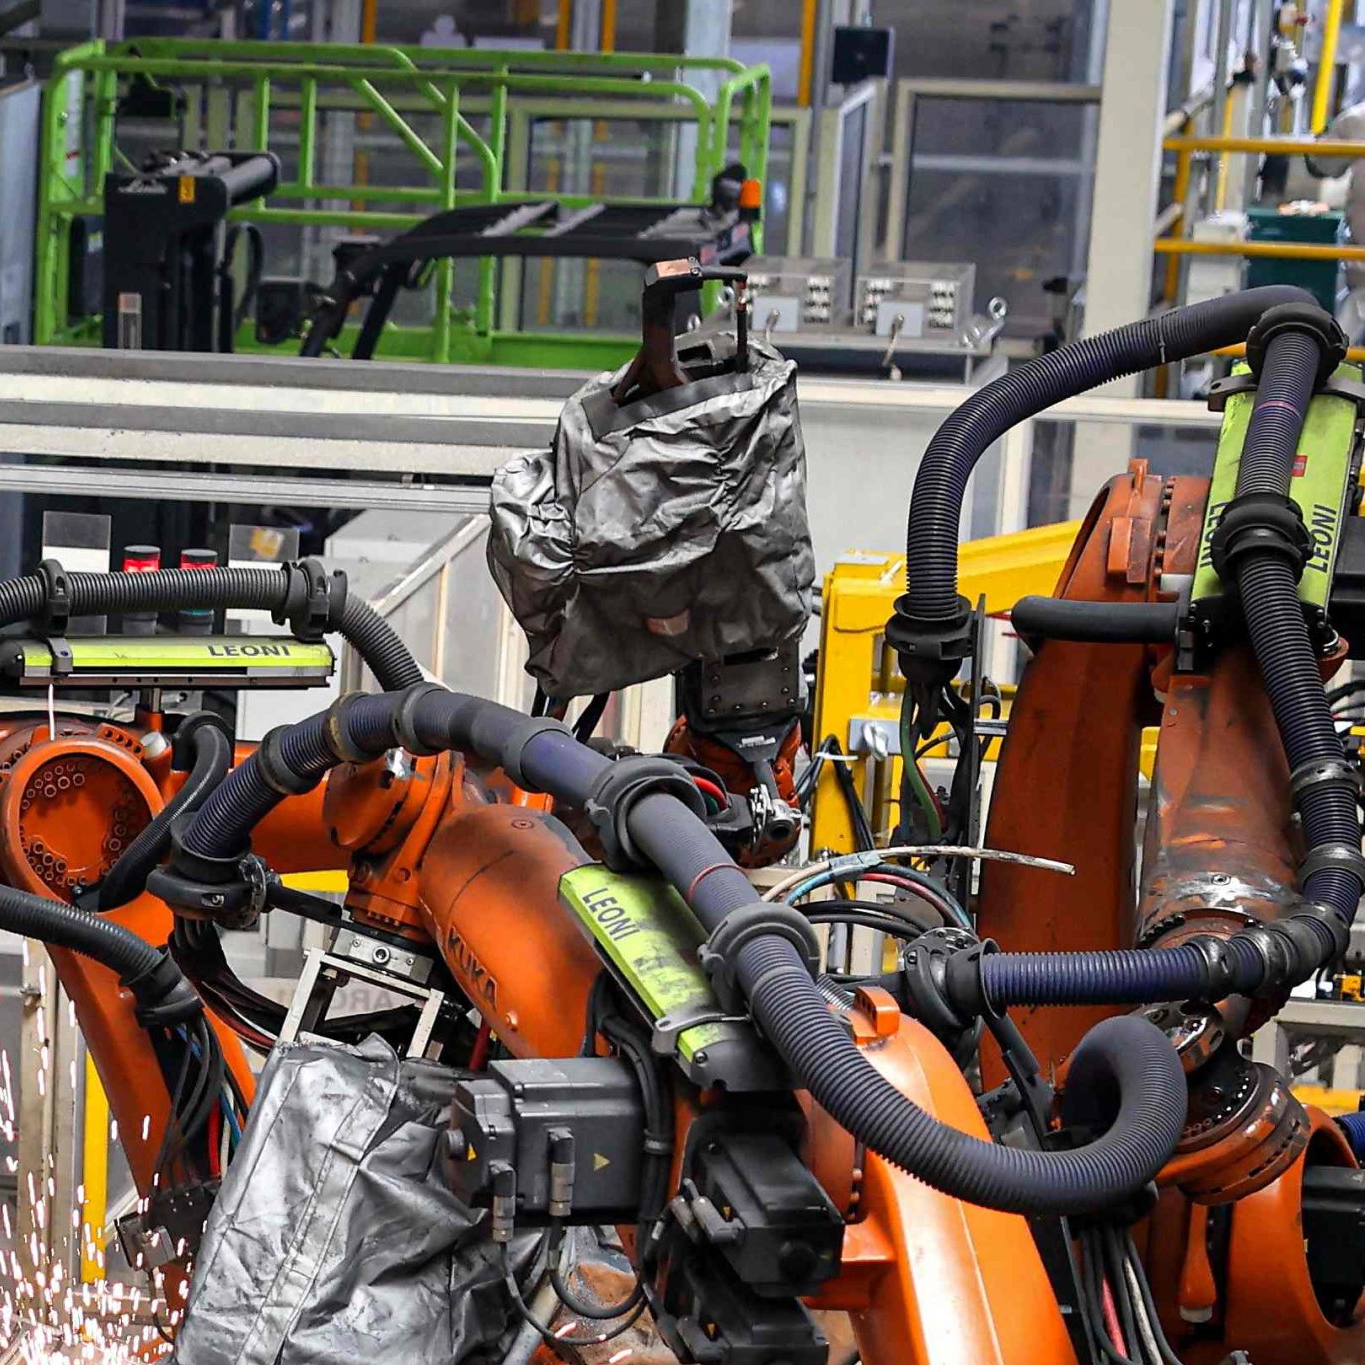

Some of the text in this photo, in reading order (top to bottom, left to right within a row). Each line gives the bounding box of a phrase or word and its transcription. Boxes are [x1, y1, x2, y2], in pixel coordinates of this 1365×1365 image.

[1306, 504, 1337, 574] LEONI
[208, 645, 291, 657] LEONI
[582, 888, 640, 941] LEONI
[448, 925, 497, 1013] KUKA
